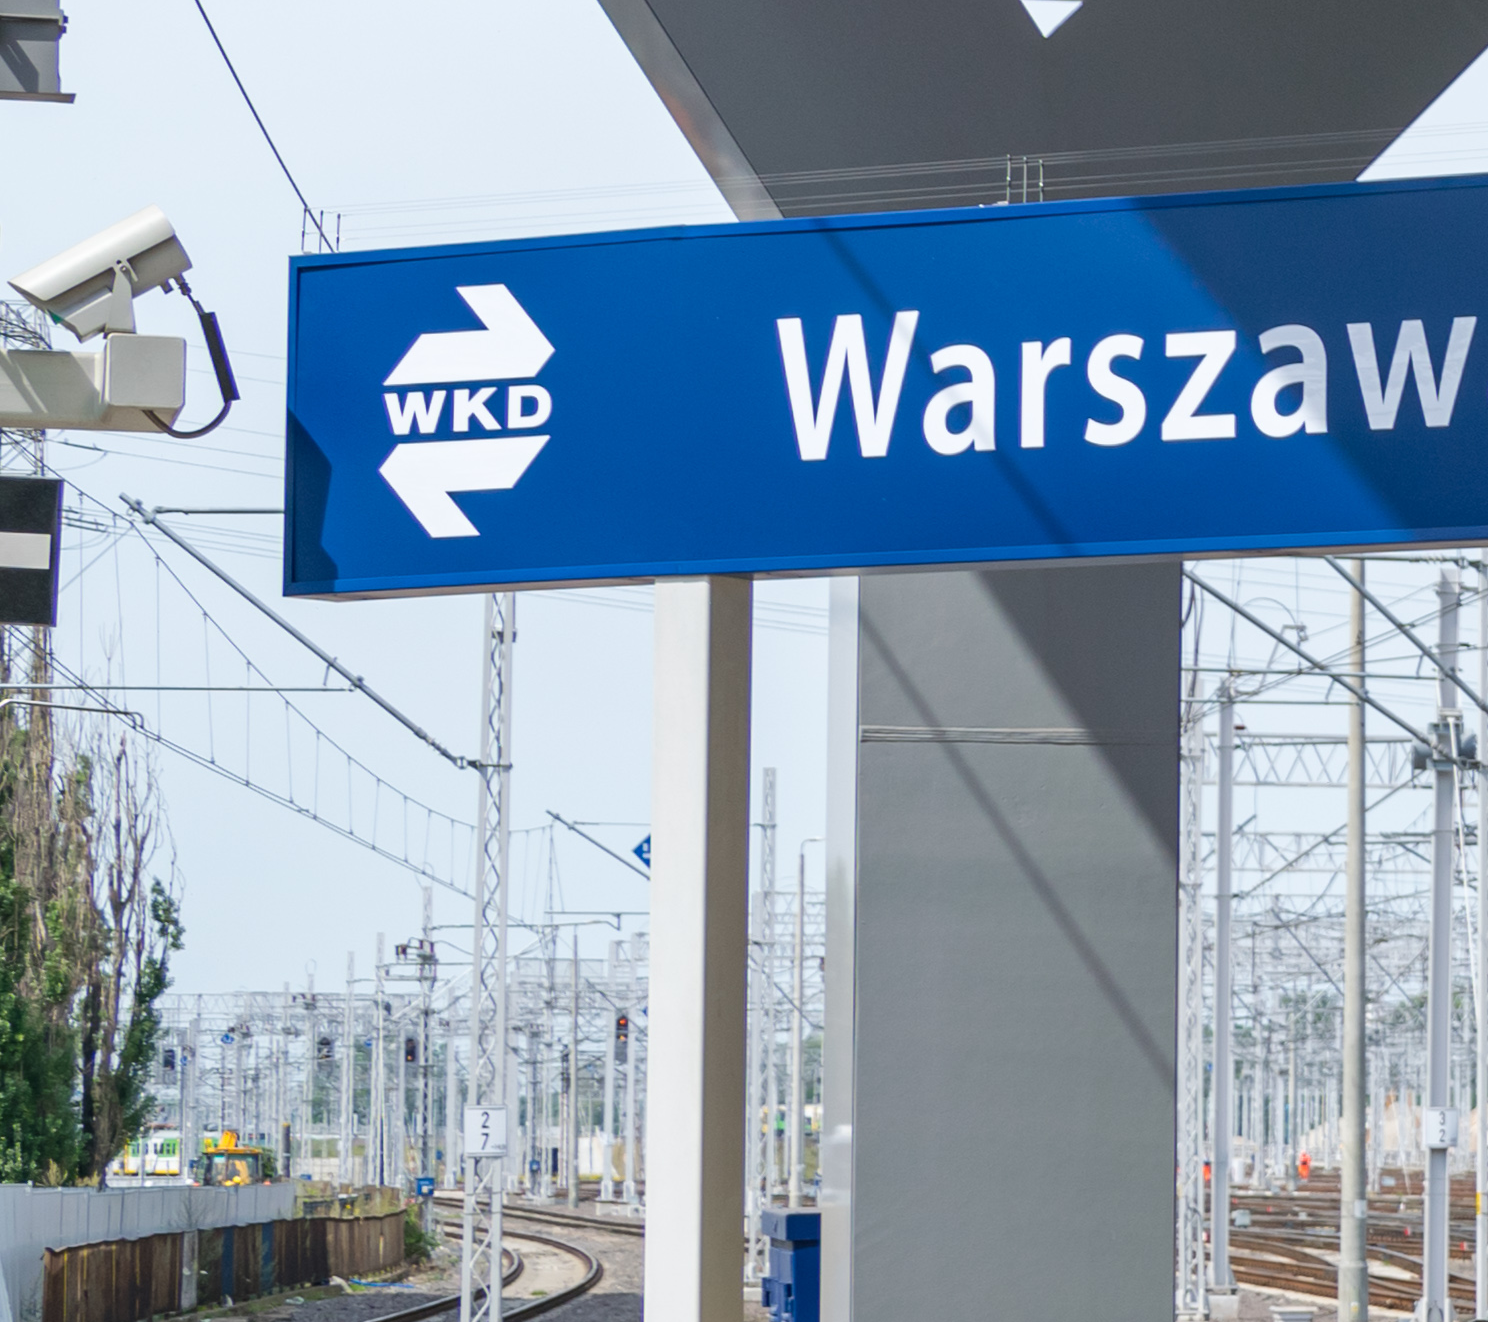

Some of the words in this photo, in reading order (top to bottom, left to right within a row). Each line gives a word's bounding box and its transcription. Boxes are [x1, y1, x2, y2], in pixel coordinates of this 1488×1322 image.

[383, 383, 553, 436] WKD
[481, 1111, 490, 1128] 2
[480, 1132, 490, 1150] 7
